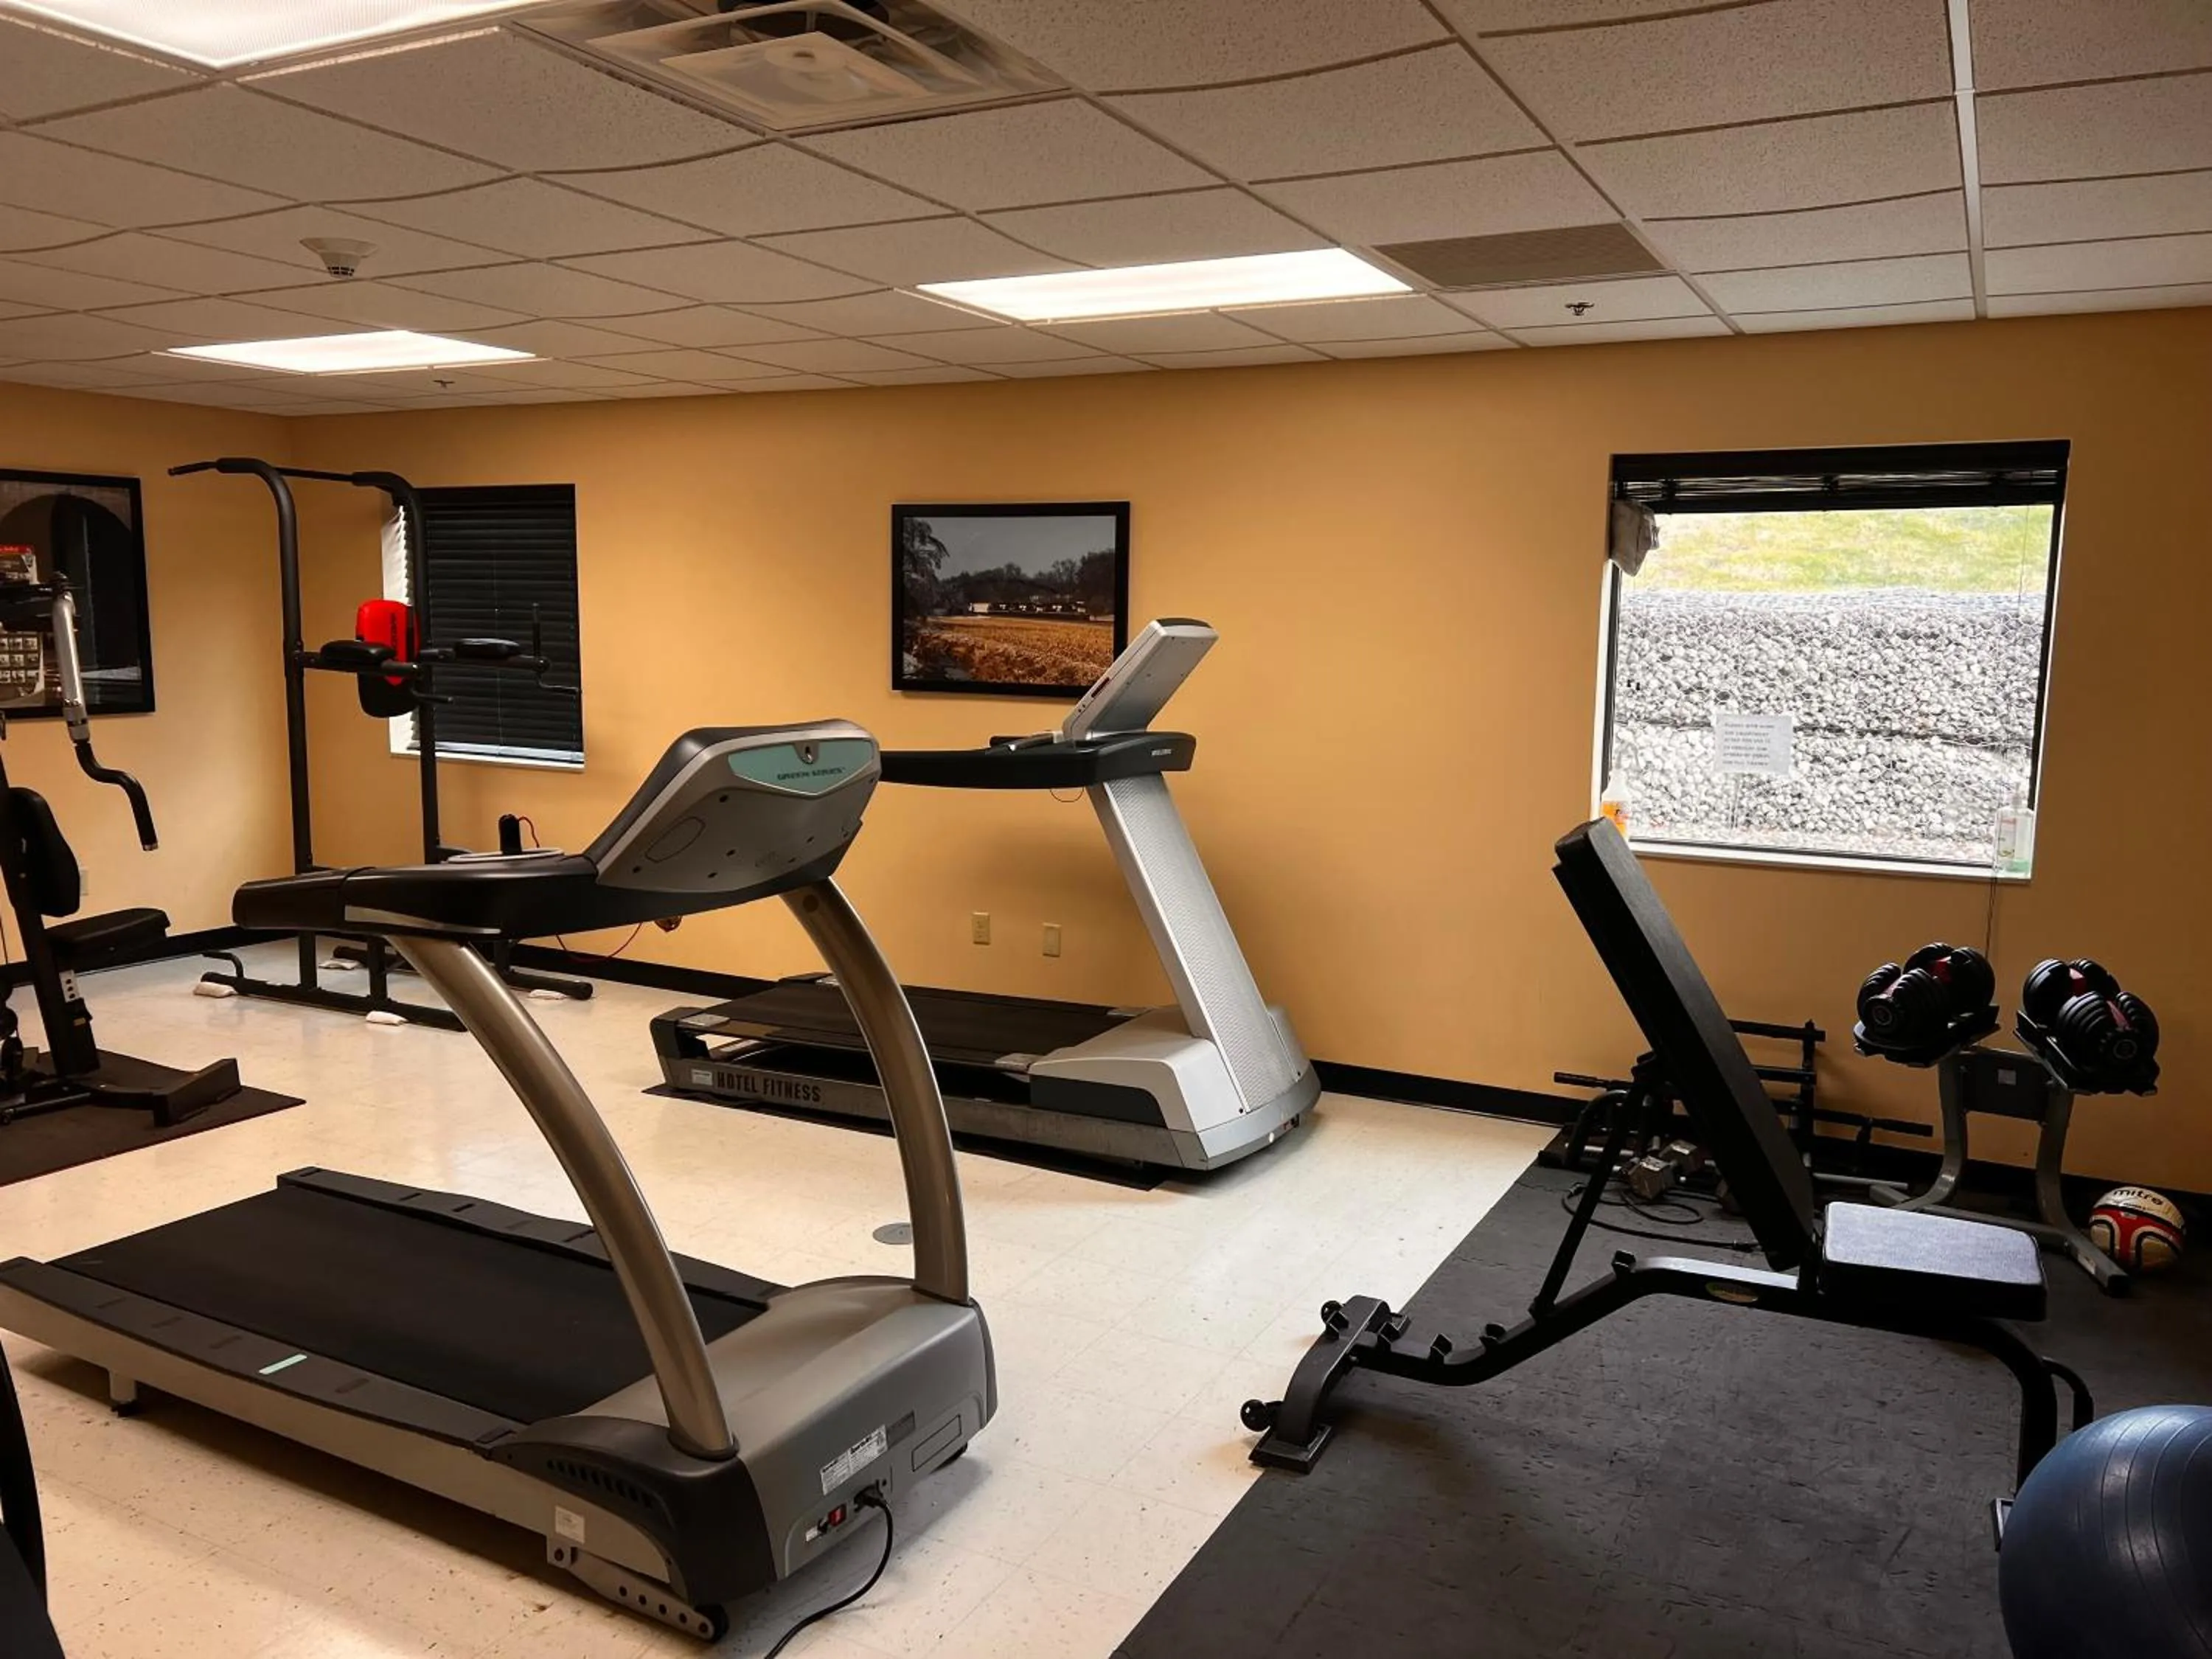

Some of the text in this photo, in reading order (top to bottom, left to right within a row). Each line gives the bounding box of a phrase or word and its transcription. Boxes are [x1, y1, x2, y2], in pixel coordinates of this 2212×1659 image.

[717, 1071, 757, 1093] HOTEL
[762, 1076, 822, 1102] FITNESS
[2113, 1189, 2164, 1206] mitre
